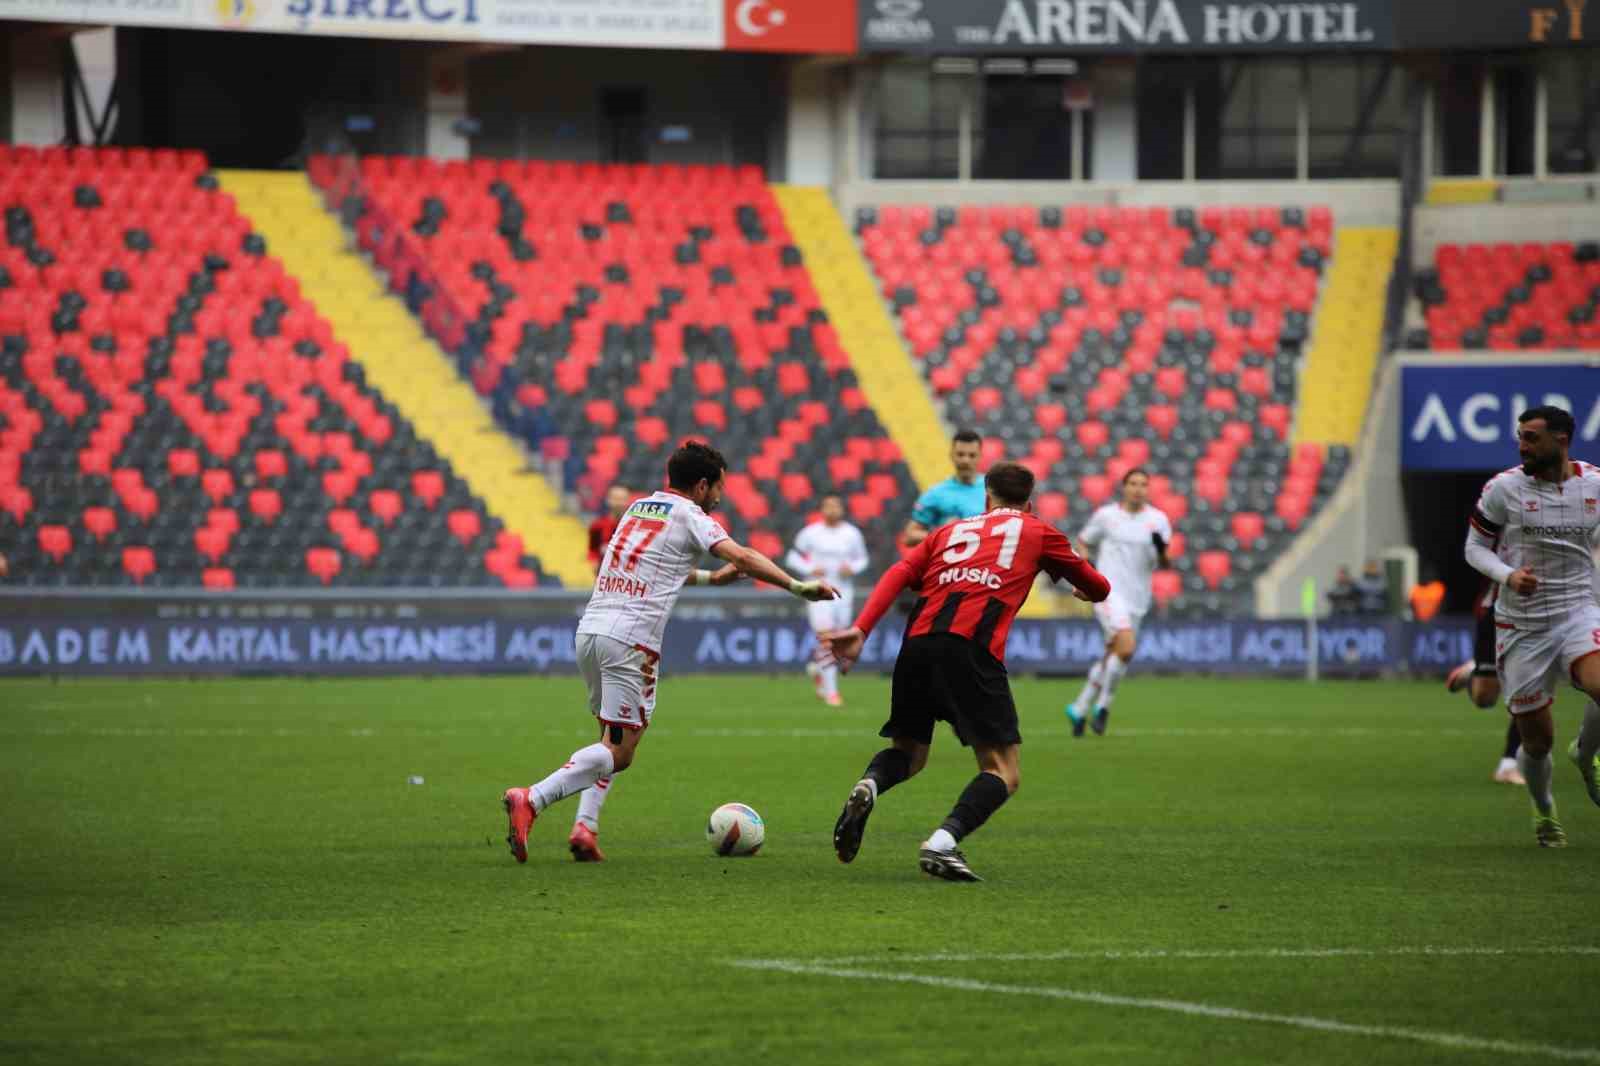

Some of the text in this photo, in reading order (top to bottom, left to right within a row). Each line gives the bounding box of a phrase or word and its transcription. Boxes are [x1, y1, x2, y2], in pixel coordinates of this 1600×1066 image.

[993, 0, 1190, 44] ARENA
[608, 517, 666, 573] 17
[942, 516, 1024, 570] 51
[598, 575, 648, 599] EMRAH
[166, 626, 300, 664] KARTAL
[309, 618, 497, 662] HASTANESİ
